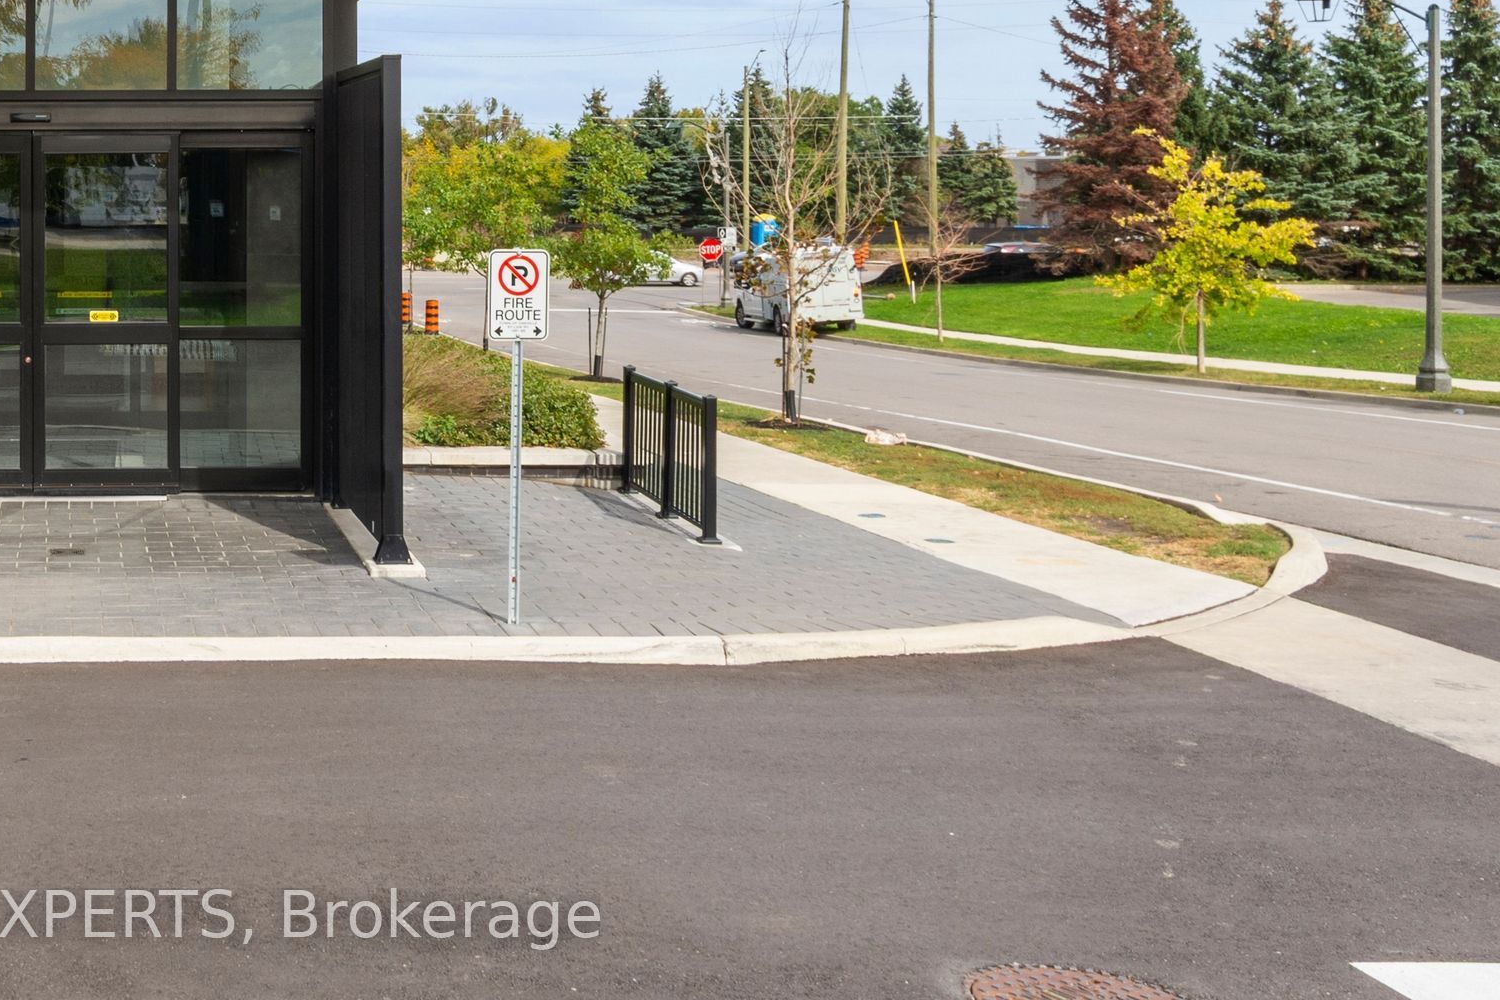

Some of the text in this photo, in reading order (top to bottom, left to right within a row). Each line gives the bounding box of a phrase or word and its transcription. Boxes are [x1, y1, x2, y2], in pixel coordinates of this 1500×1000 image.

[701, 245, 721, 255] STOP
[503, 297, 533, 309] FIRE
[495, 309, 541, 321] ROUTE
